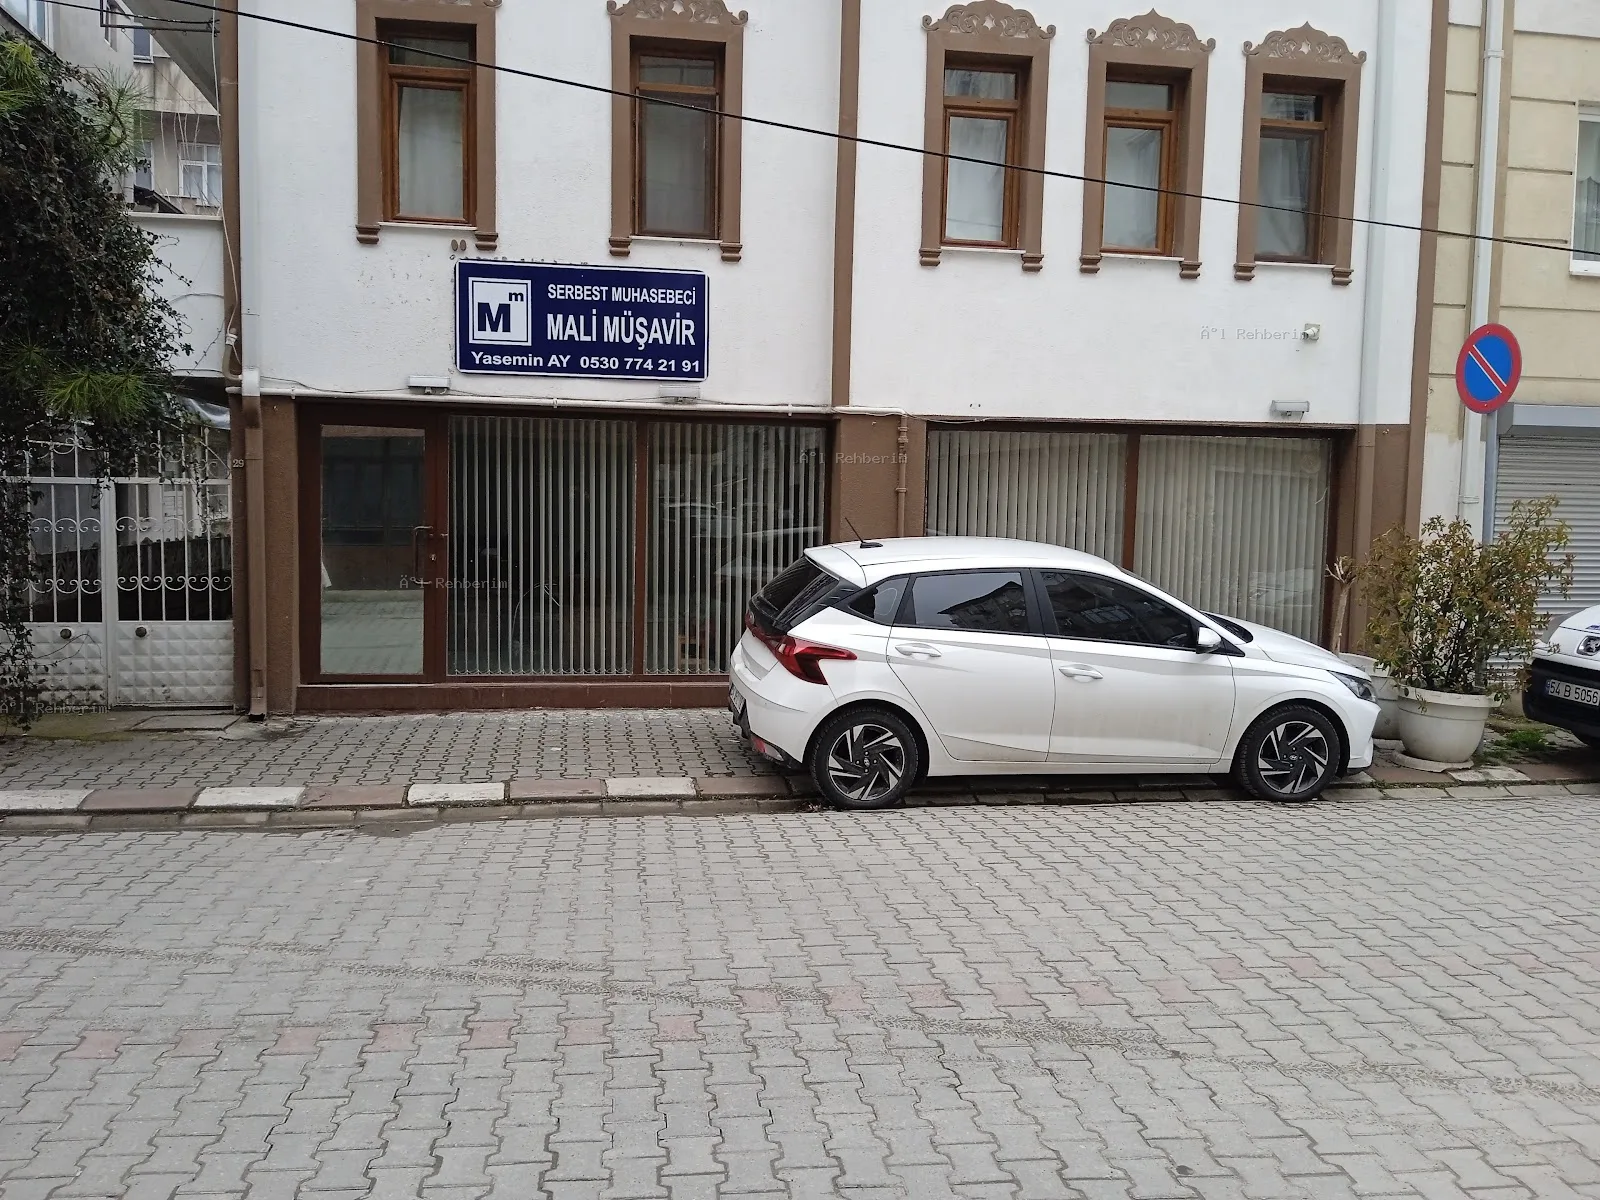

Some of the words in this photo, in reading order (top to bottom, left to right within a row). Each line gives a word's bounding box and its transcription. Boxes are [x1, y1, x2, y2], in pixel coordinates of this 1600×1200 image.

[547, 284, 608, 301] SERBEST
[612, 287, 696, 305] MUHASEBECİ
[547, 309, 597, 342] MALİ
[603, 311, 695, 350] MÜŞAVİR
[471, 351, 544, 367] Yasemin
[547, 354, 571, 368] AY
[580, 356, 619, 370] 0530
[624, 358, 653, 371] 774
[658, 359, 676, 372] 21
[682, 360, 699, 373] 91
[232, 458, 244, 468] 29
[1550, 681, 1561, 695] 54
[1564, 684, 1571, 698] B
[1575, 687, 1599, 704] 5056
